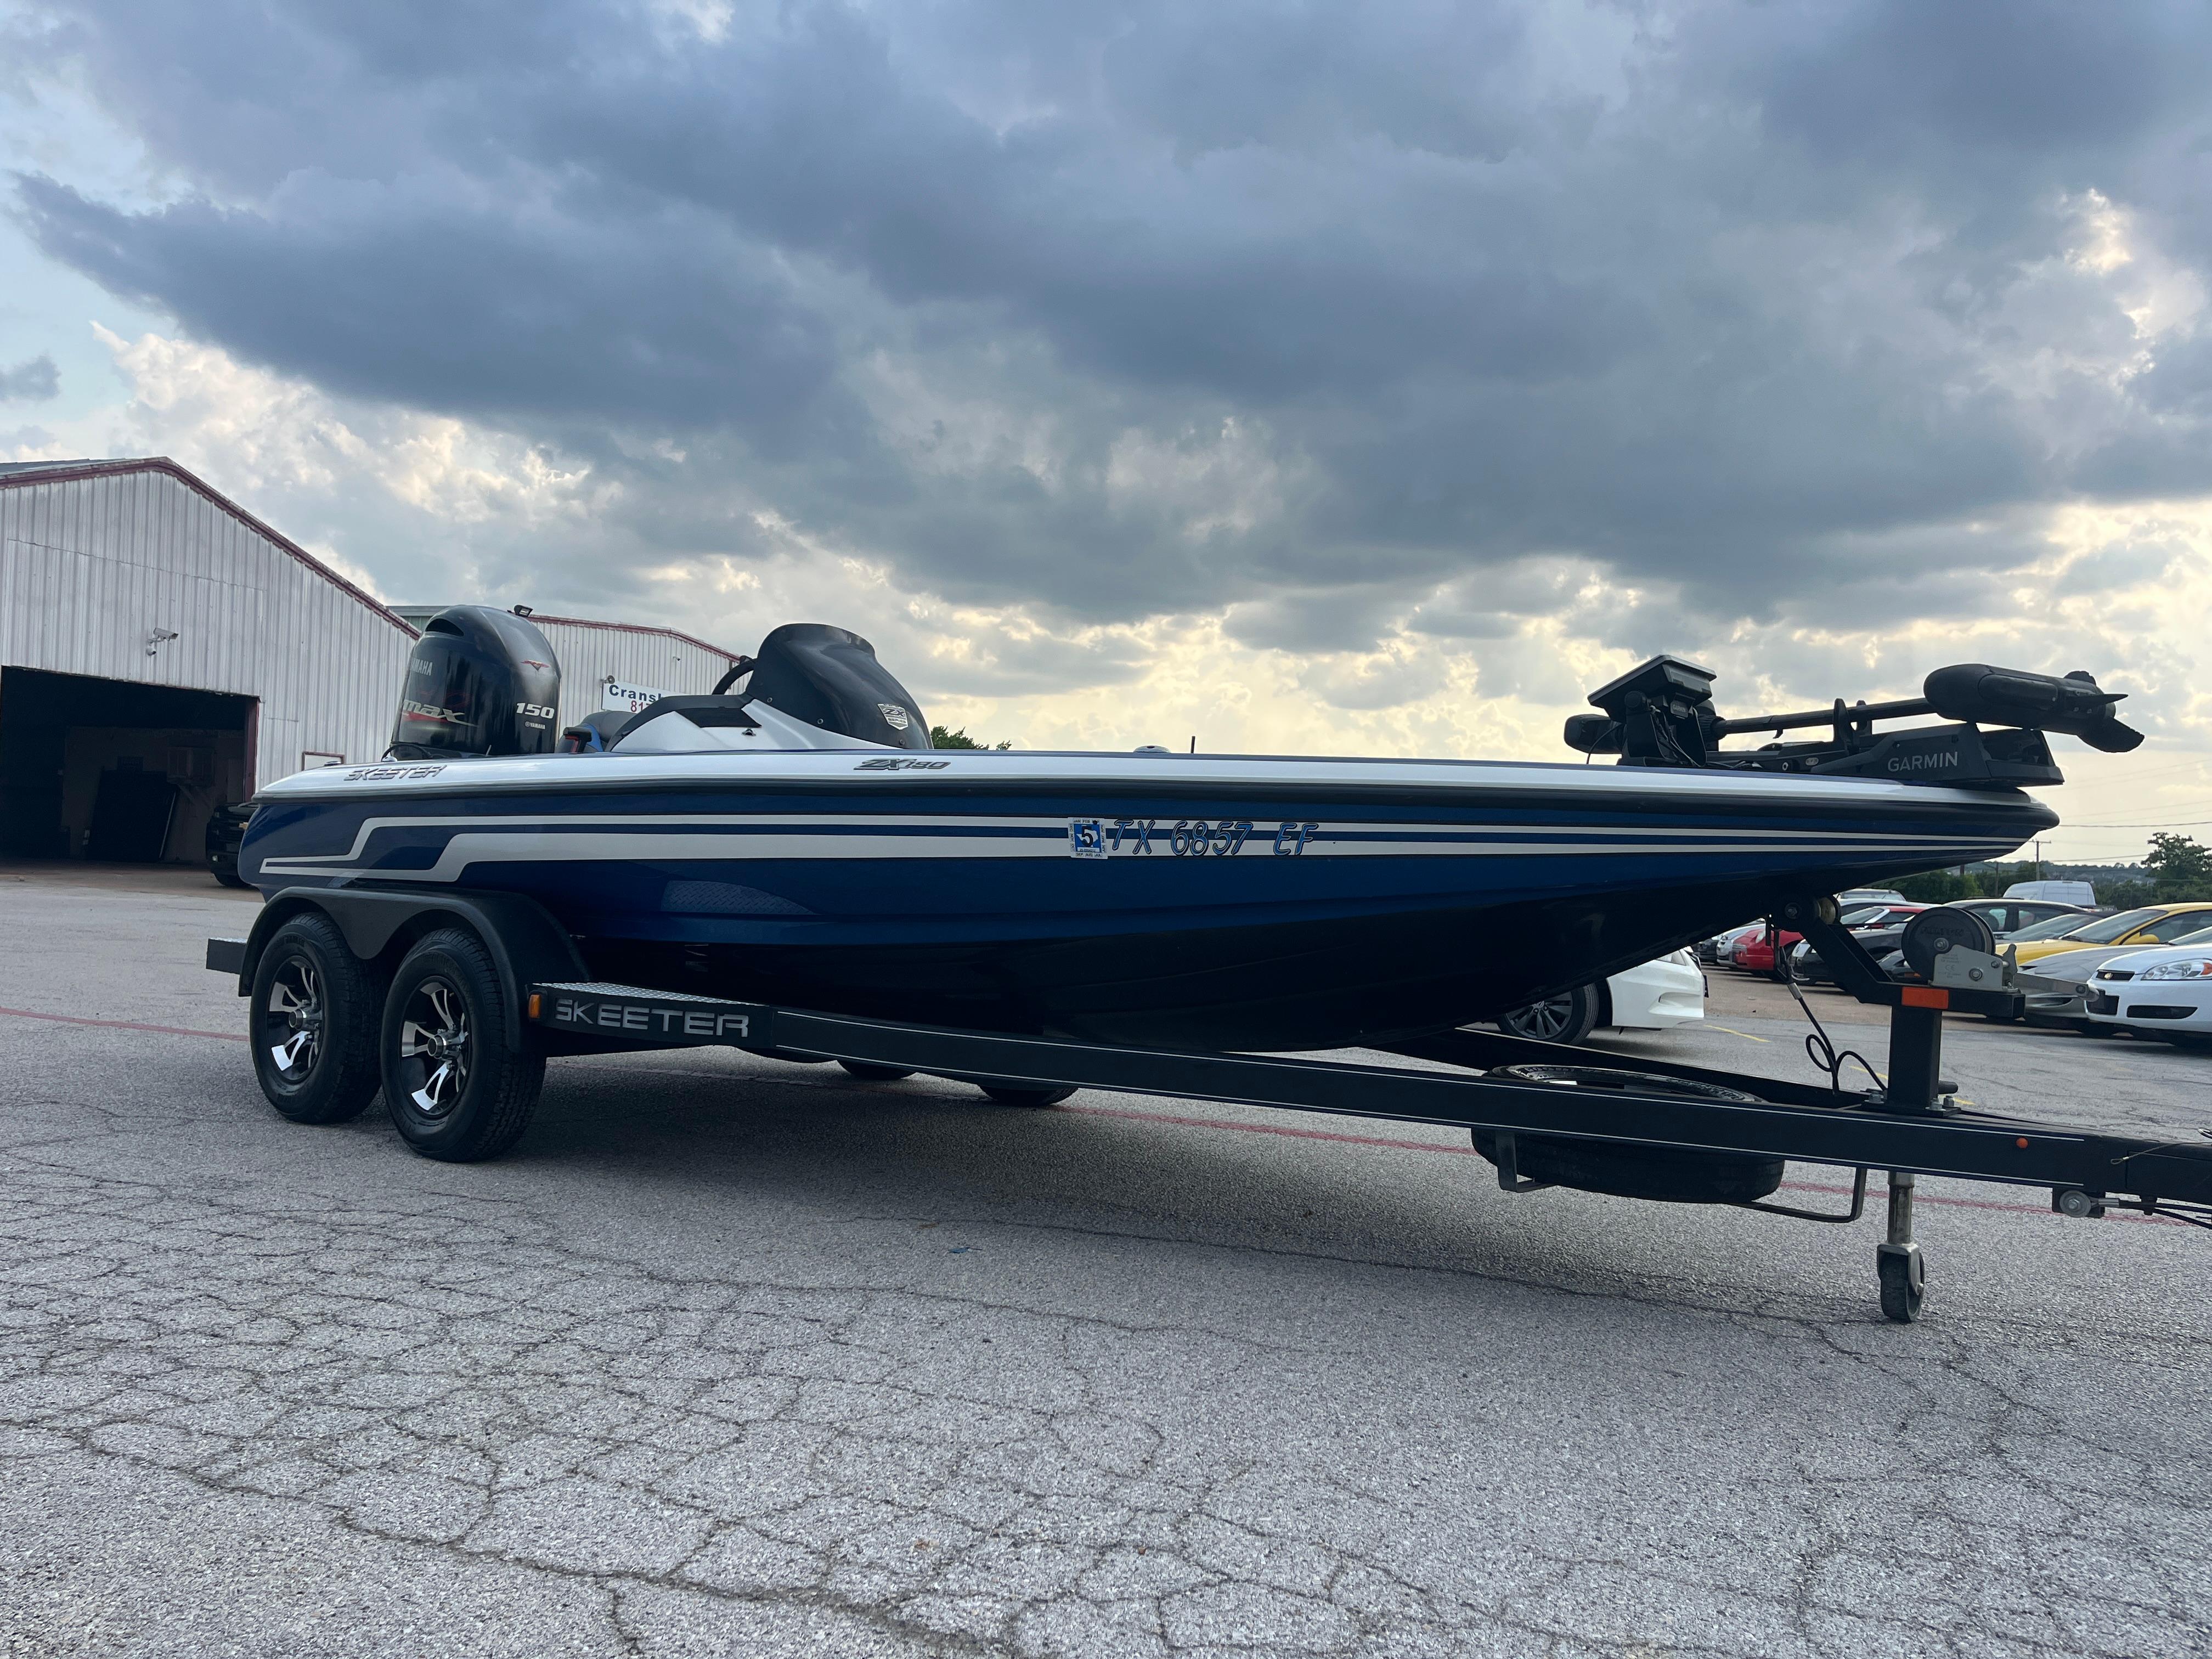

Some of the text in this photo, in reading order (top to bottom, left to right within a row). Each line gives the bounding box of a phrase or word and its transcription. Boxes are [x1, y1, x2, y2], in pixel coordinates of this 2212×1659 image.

[516, 702, 555, 719] 150
[1887, 751, 1958, 772] GARMIN
[343, 764, 448, 781] SKEETER
[1082, 826, 1094, 848] 5
[1112, 820, 1319, 856] TX 6857 EF
[555, 998, 749, 1038] SKEETER
